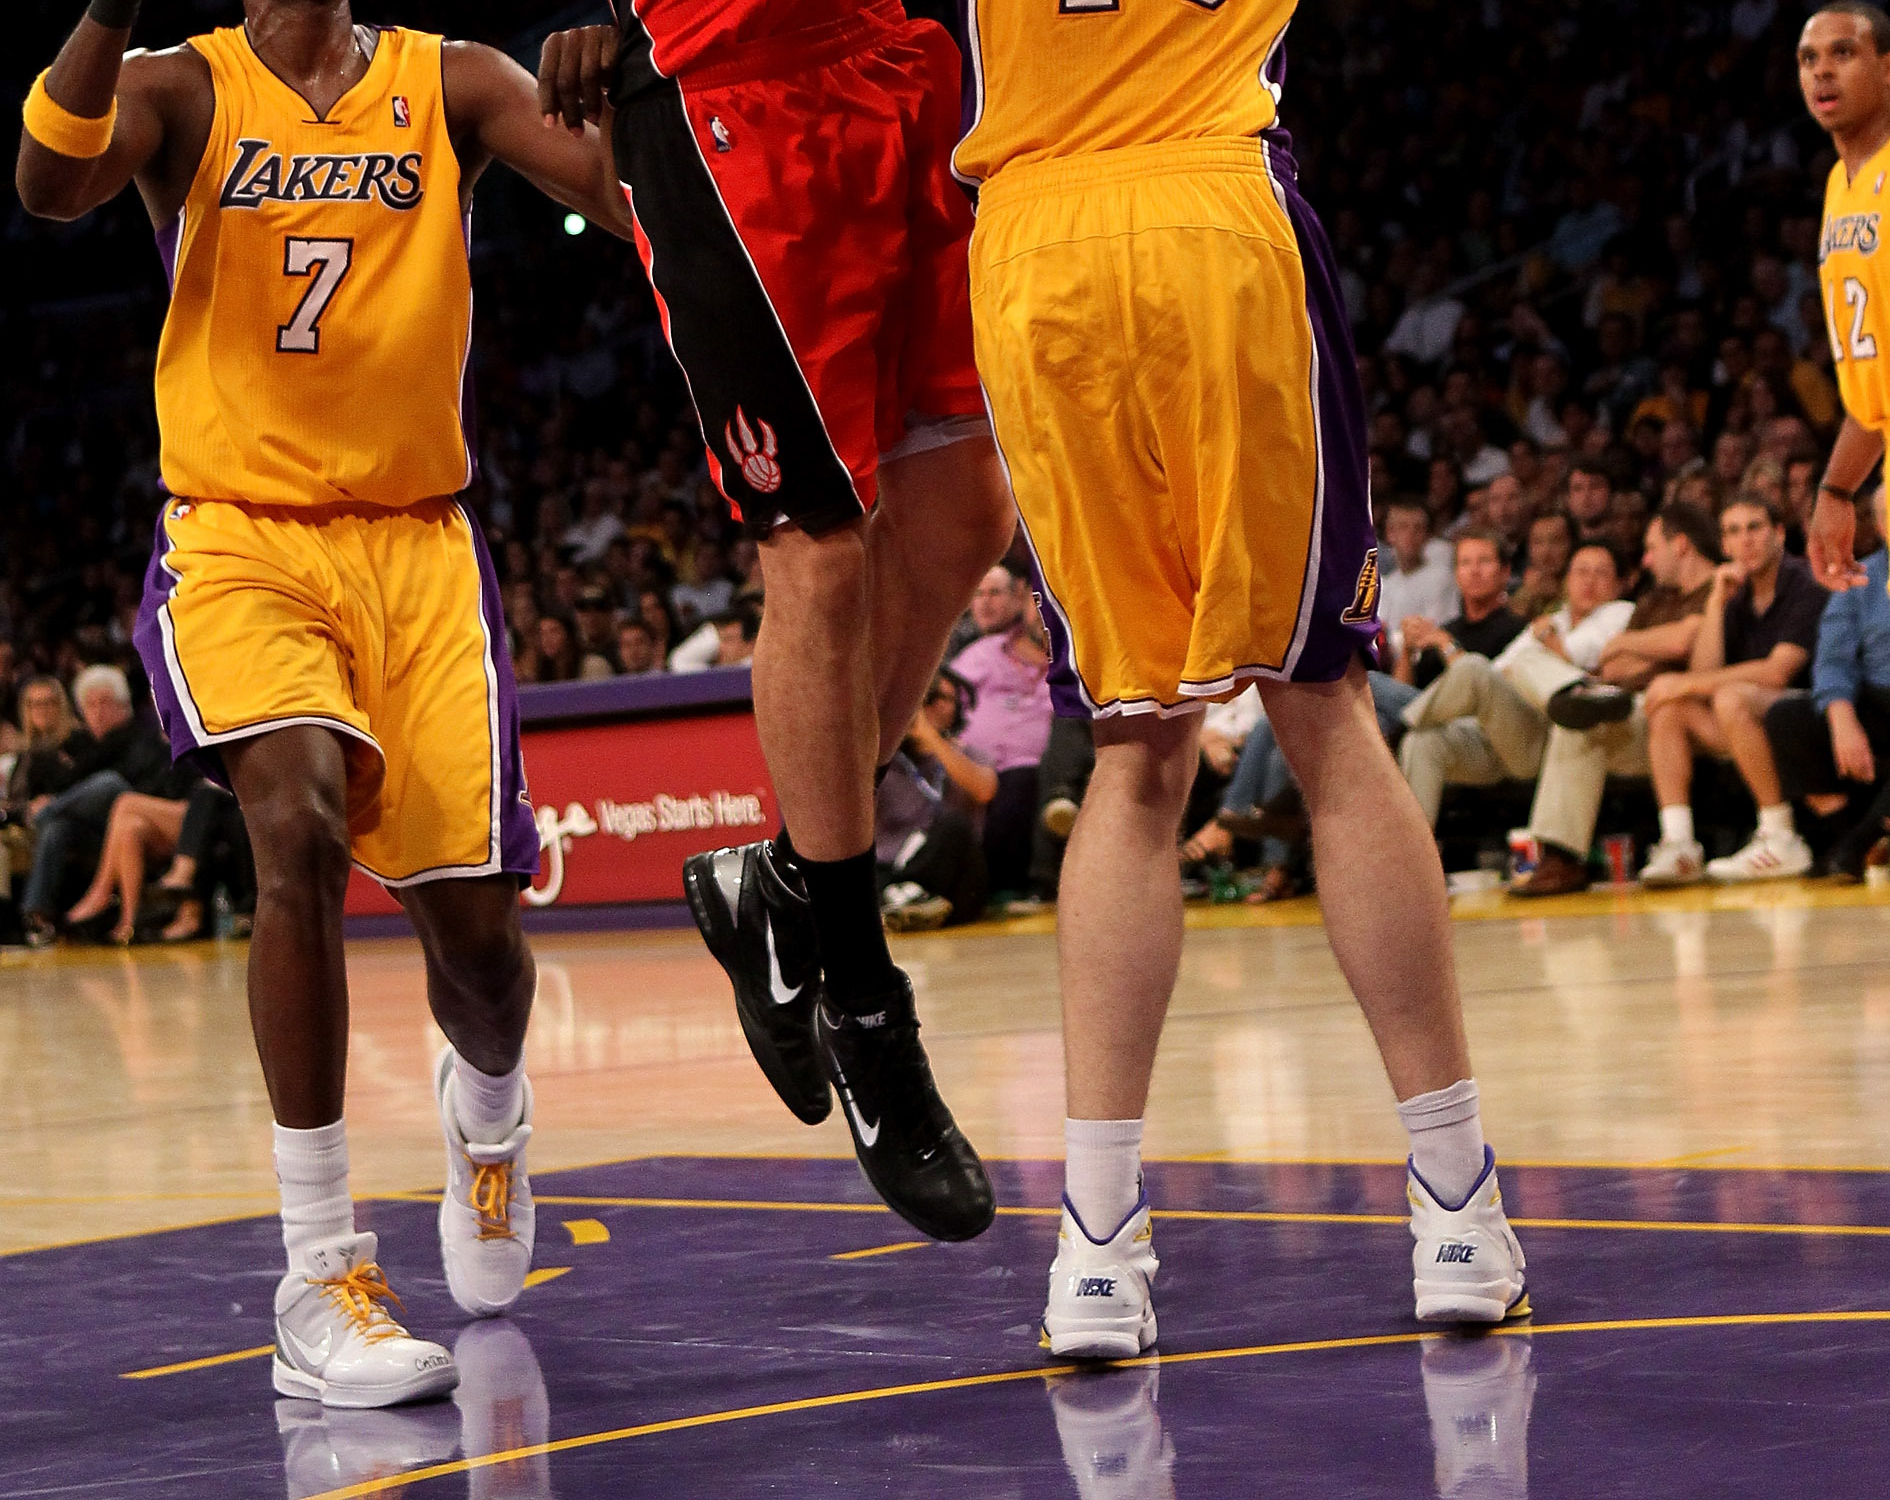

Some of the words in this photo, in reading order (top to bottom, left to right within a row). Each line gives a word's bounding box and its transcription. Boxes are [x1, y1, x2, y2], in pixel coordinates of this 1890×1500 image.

[219, 138, 425, 211] LAKERS
[1818, 212, 1881, 266] AKERS
[275, 235, 355, 355] 7
[597, 798, 657, 841] Vegas
[654, 792, 714, 832] Starts
[1435, 1243, 1479, 1263] NIKE
[1076, 1277, 1118, 1297] NIKE
